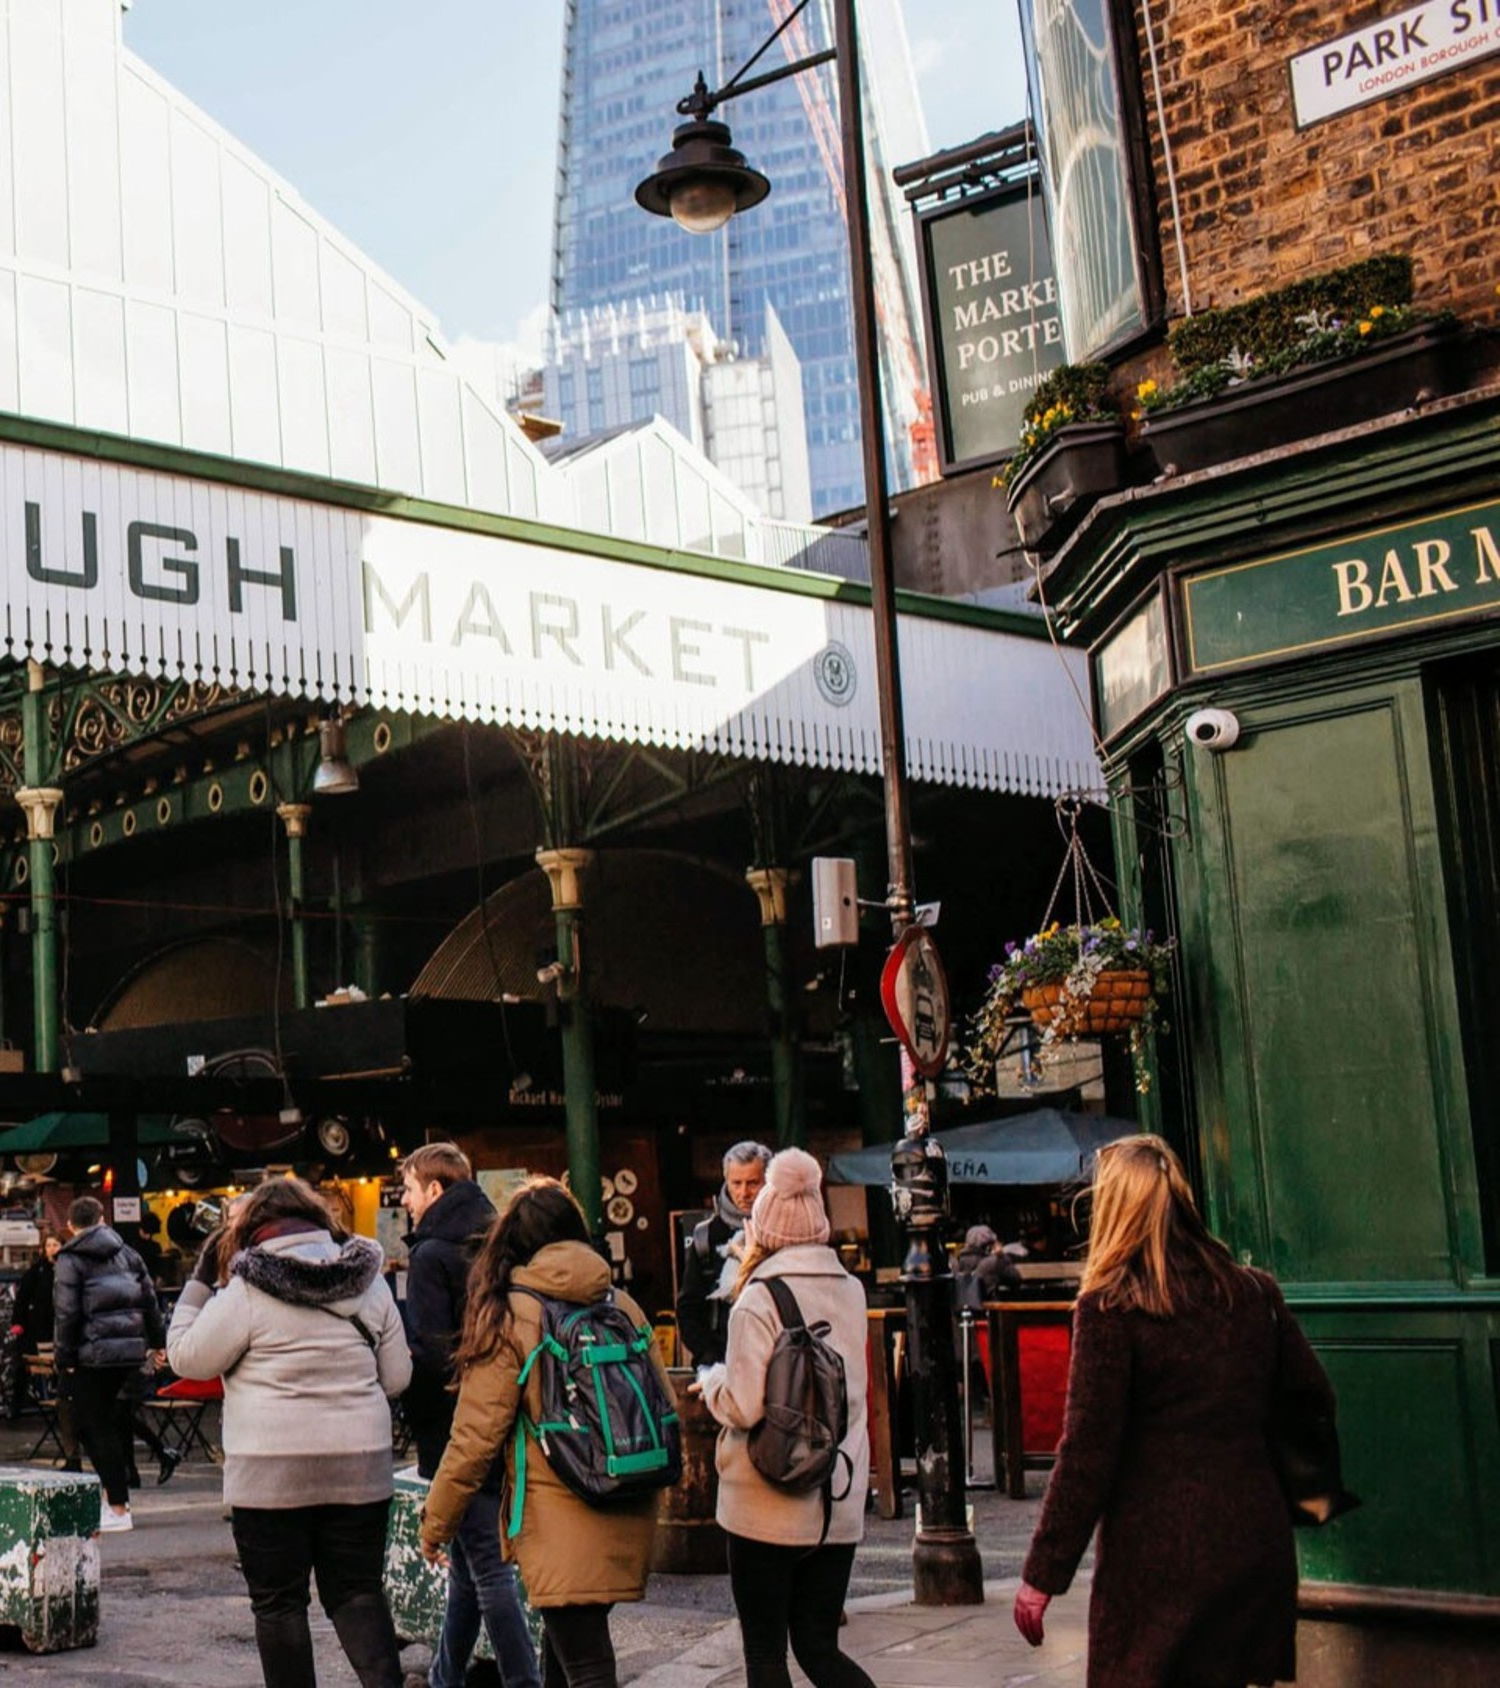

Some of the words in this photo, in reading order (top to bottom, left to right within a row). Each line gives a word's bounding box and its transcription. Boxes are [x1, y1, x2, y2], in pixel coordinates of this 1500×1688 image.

[1323, 14, 1428, 86] PARK
[1359, 63, 1415, 93] LONDON
[1421, 33, 1489, 68] BOROUGH
[949, 251, 1011, 290] THE
[953, 277, 1057, 331] MARKE
[958, 317, 1061, 370] PORTE
[962, 390, 988, 406] PUB
[993, 385, 1005, 396] &
[1332, 539, 1459, 616] BAR
[362, 560, 770, 693] MARKET
